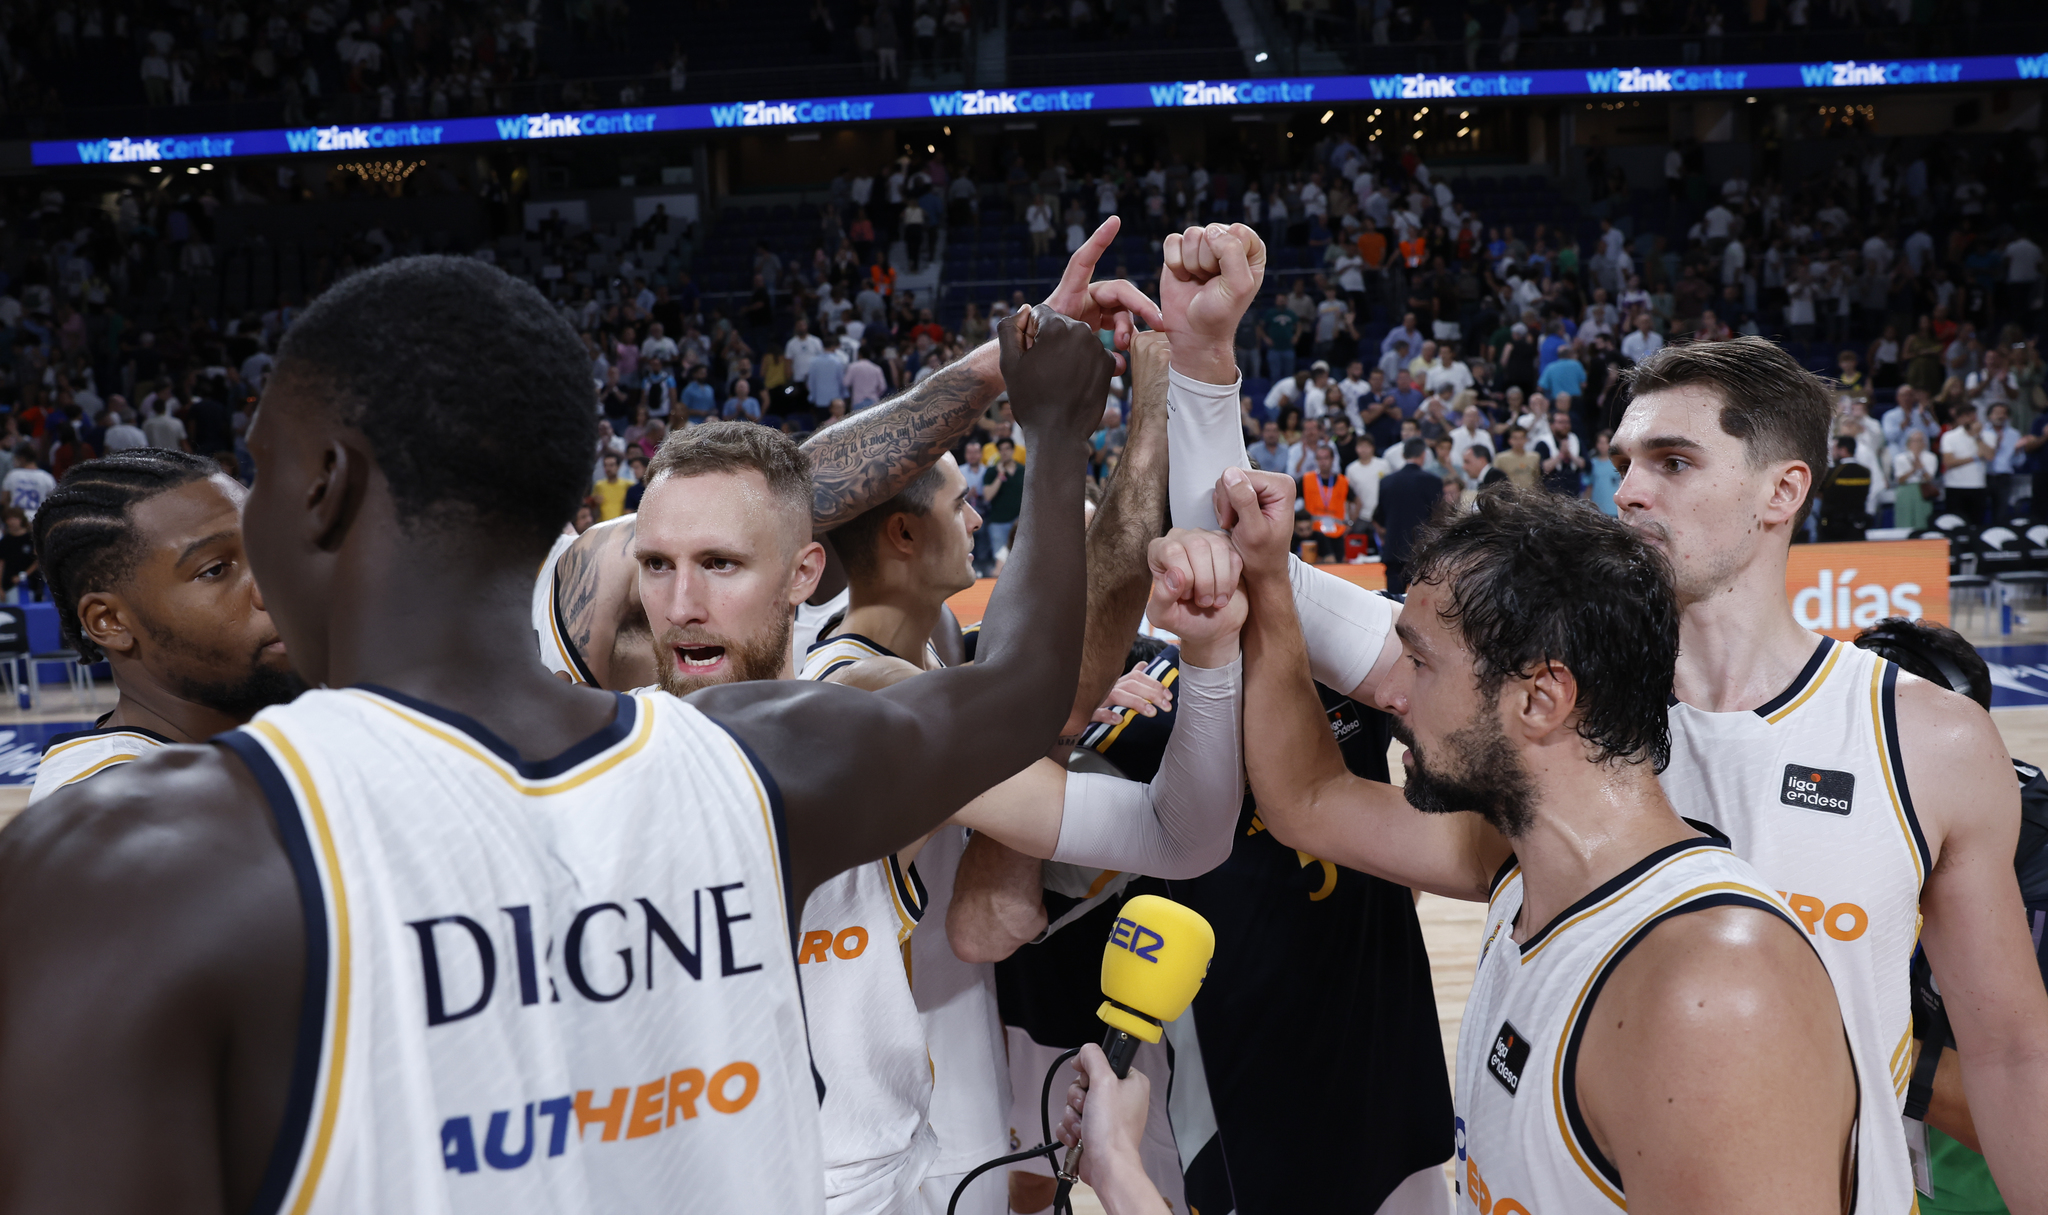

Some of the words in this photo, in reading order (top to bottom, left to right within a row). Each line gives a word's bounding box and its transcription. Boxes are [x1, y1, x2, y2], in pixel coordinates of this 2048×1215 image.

[1792, 568, 1924, 630] días
[1786, 790, 1849, 811] endesa
[1788, 776, 1817, 792] liga
[1775, 889, 1869, 942] RO
[798, 925, 870, 965] RO
[1495, 1036, 1509, 1059] liga
[1490, 1054, 1519, 1089] endesa
